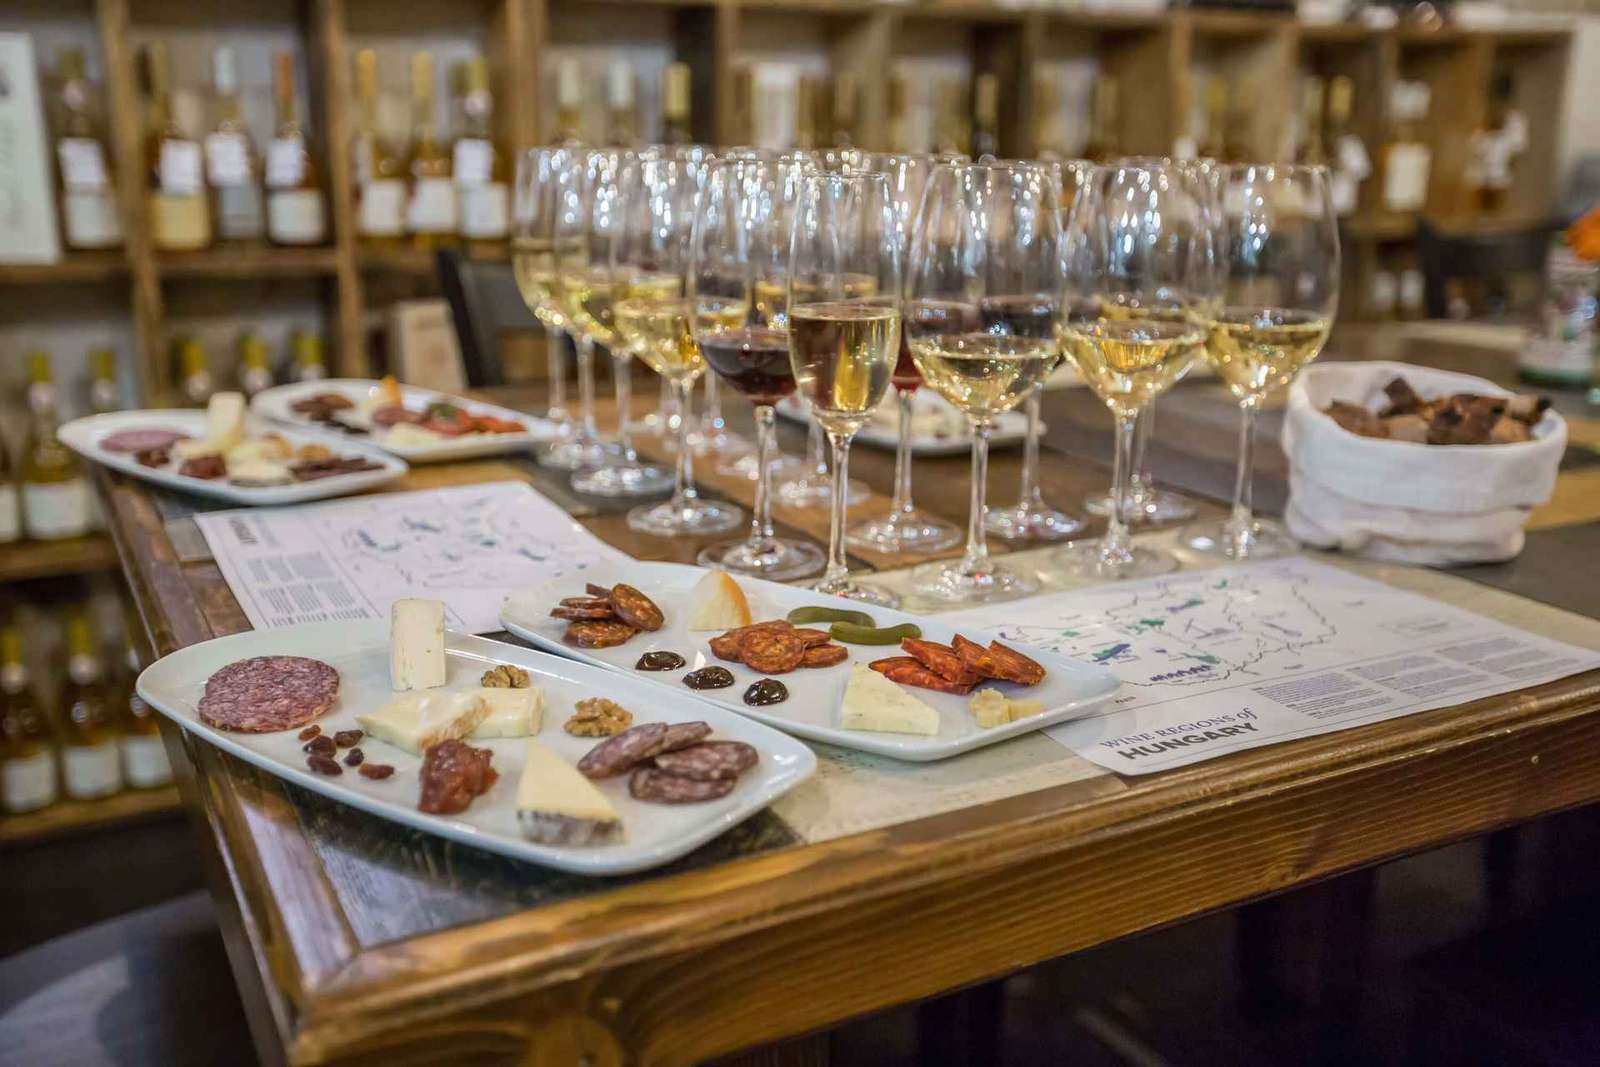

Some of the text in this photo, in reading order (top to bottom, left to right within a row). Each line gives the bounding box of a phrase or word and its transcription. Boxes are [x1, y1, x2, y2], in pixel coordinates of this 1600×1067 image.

[1101, 706, 1258, 748] WINE REGIONS of
[1117, 722, 1259, 760] HUNGARY
